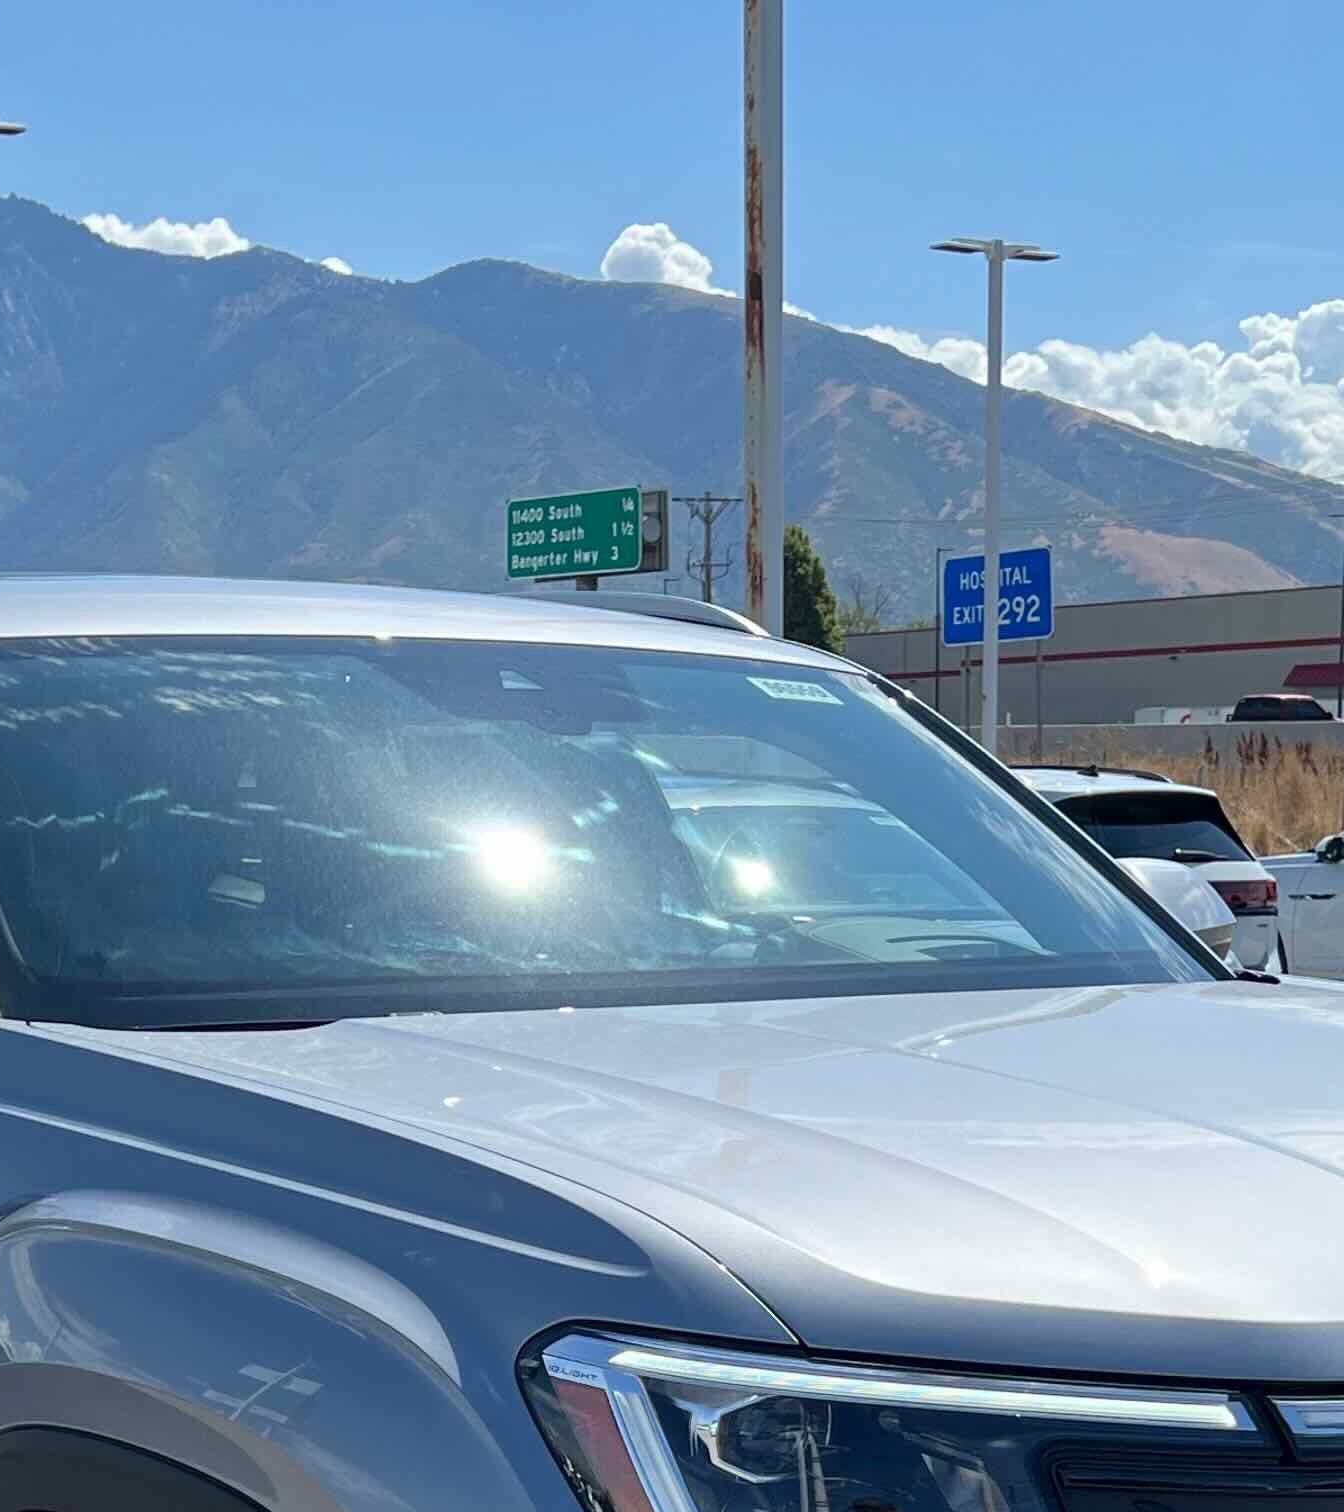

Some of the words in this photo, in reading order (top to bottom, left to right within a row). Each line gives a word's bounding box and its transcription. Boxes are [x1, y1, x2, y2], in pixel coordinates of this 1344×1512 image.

[512, 507, 544, 525] 11400
[548, 503, 582, 521] South
[512, 530, 545, 546] 12300
[551, 526, 585, 543] South
[612, 522, 617, 537] 1
[511, 550, 568, 571] Bangerter
[574, 548, 599, 566] Hwy
[611, 546, 619, 561] 3
[959, 566, 1033, 591] HOSITAL
[953, 604, 984, 625] EXIT
[998, 594, 1041, 625] 292
